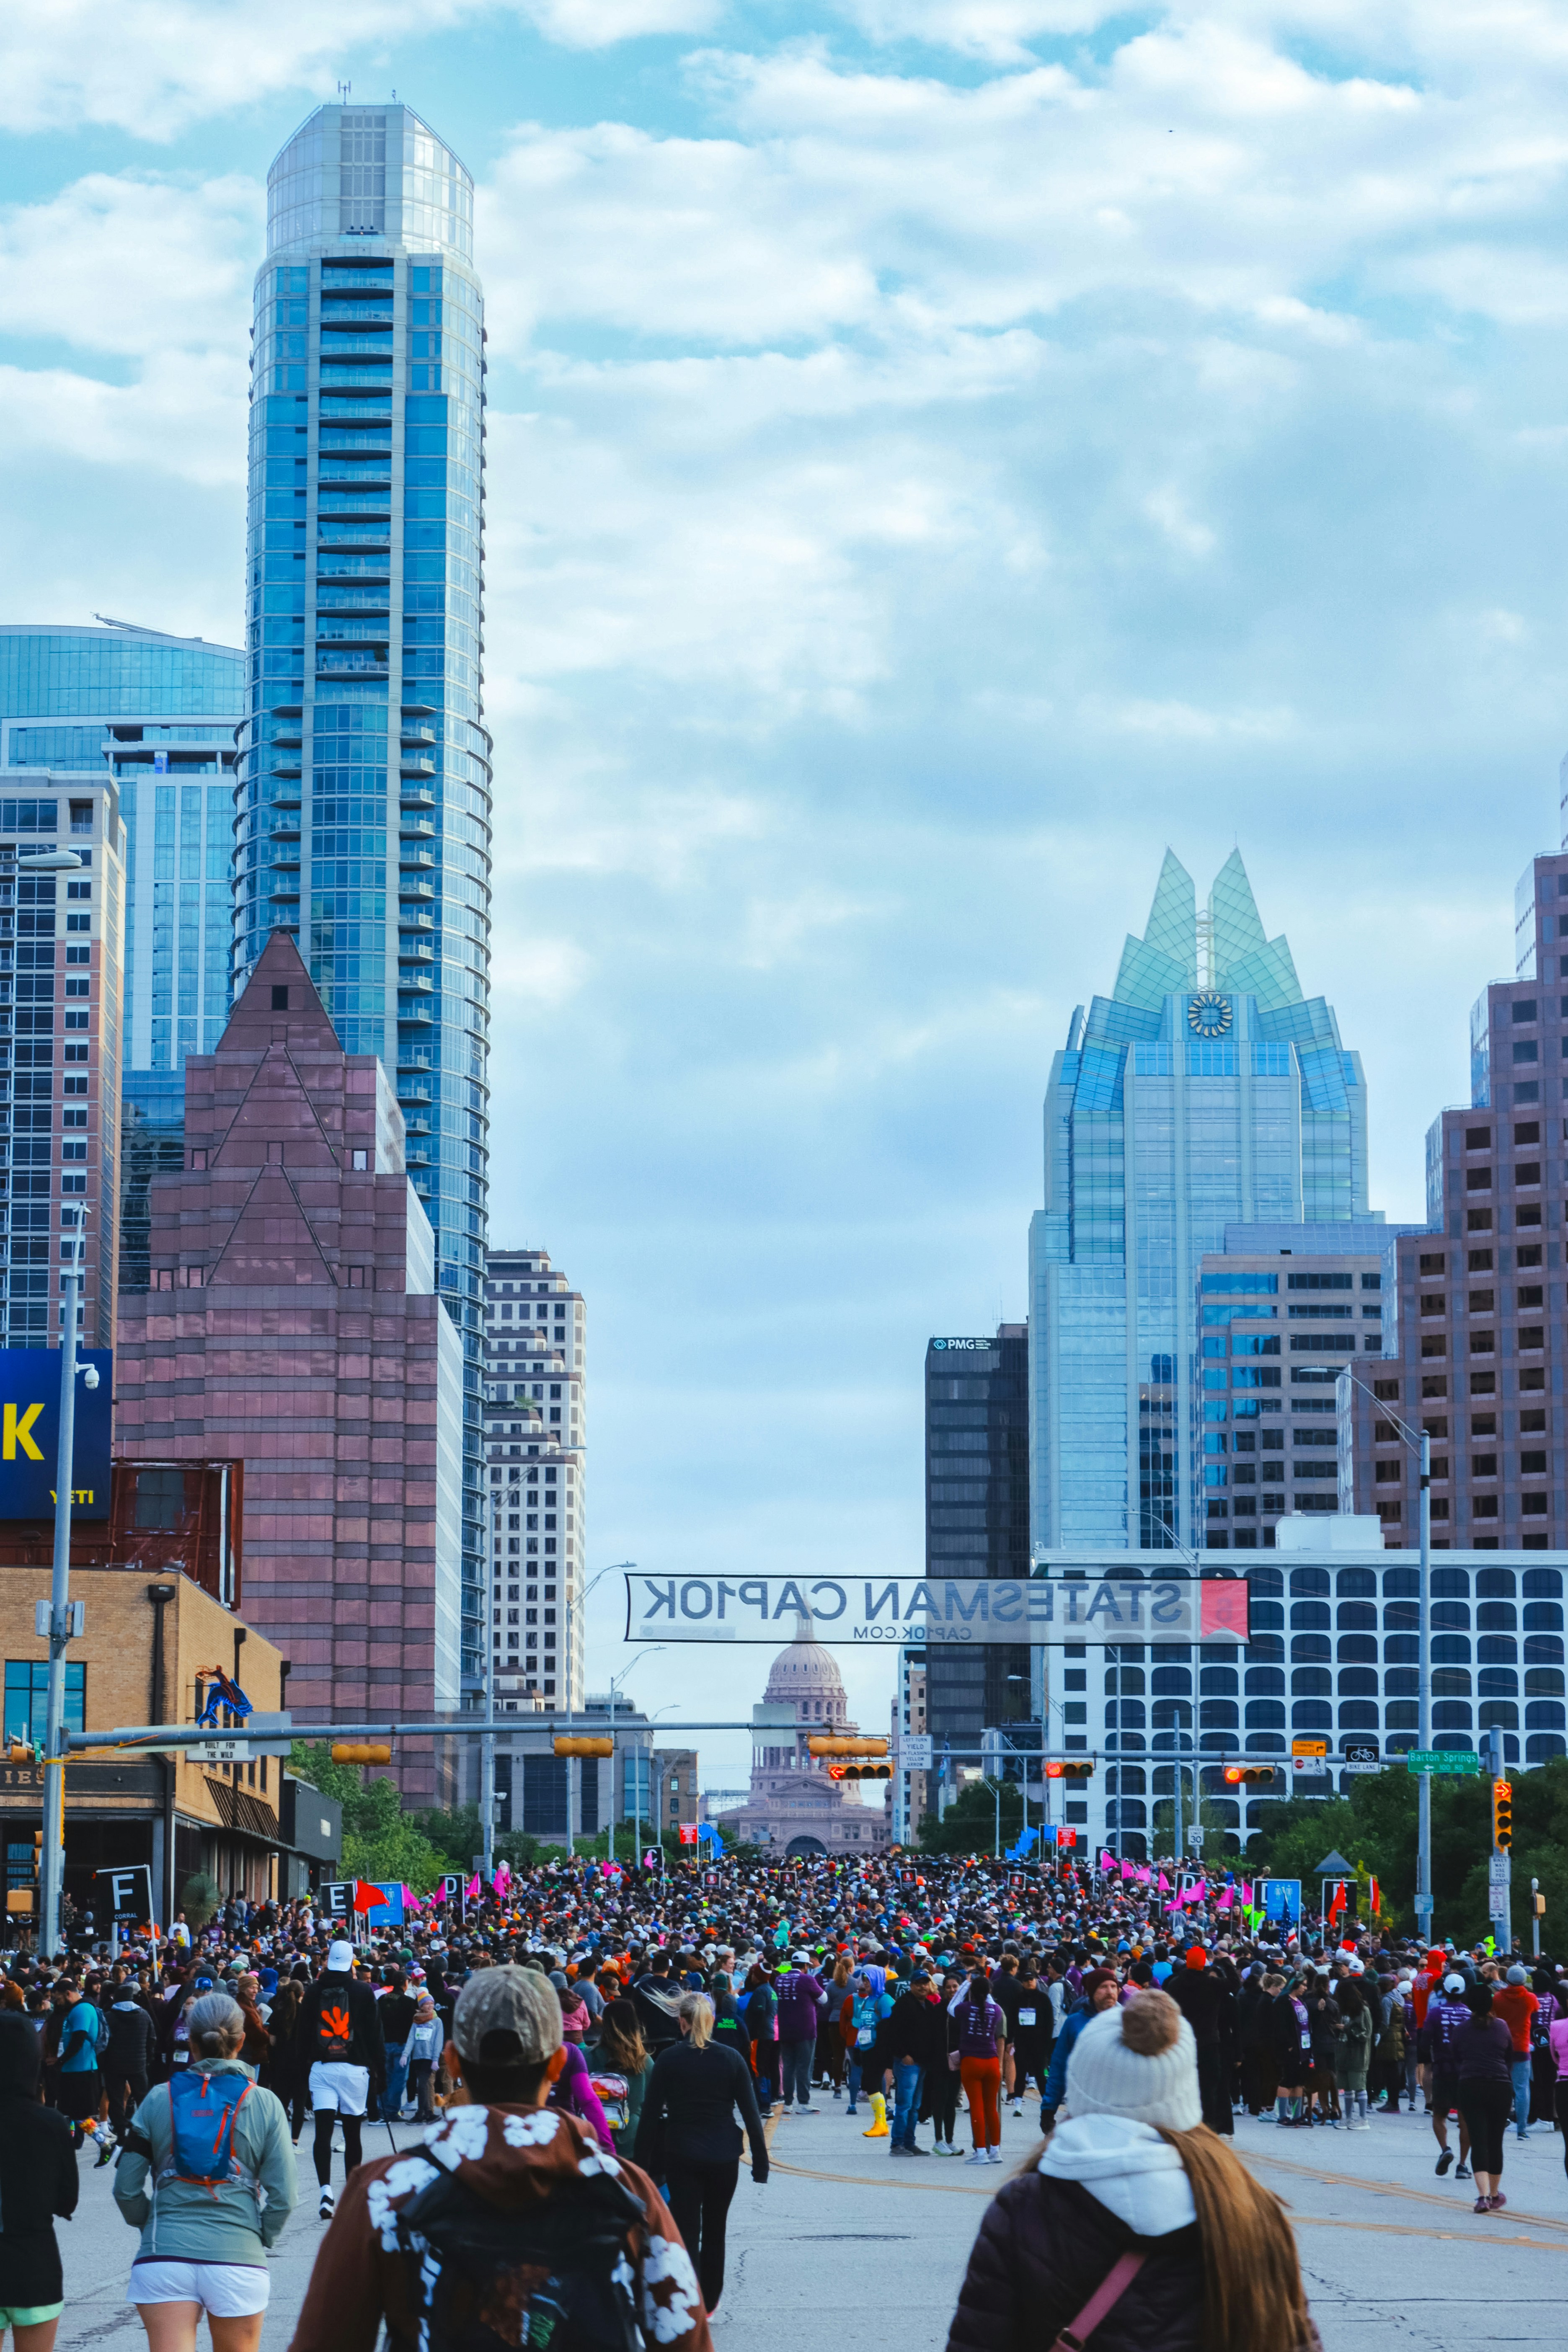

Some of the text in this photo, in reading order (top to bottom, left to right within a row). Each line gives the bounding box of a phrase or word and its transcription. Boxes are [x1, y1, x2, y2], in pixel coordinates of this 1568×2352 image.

[948, 1339, 974, 1350] PMG
[3, 1403, 45, 1460] K
[1410, 1752, 1476, 1764] Barton Springs
[112, 1874, 134, 1910] F
[445, 1877, 457, 1894] D
[330, 1886, 346, 1910] E
